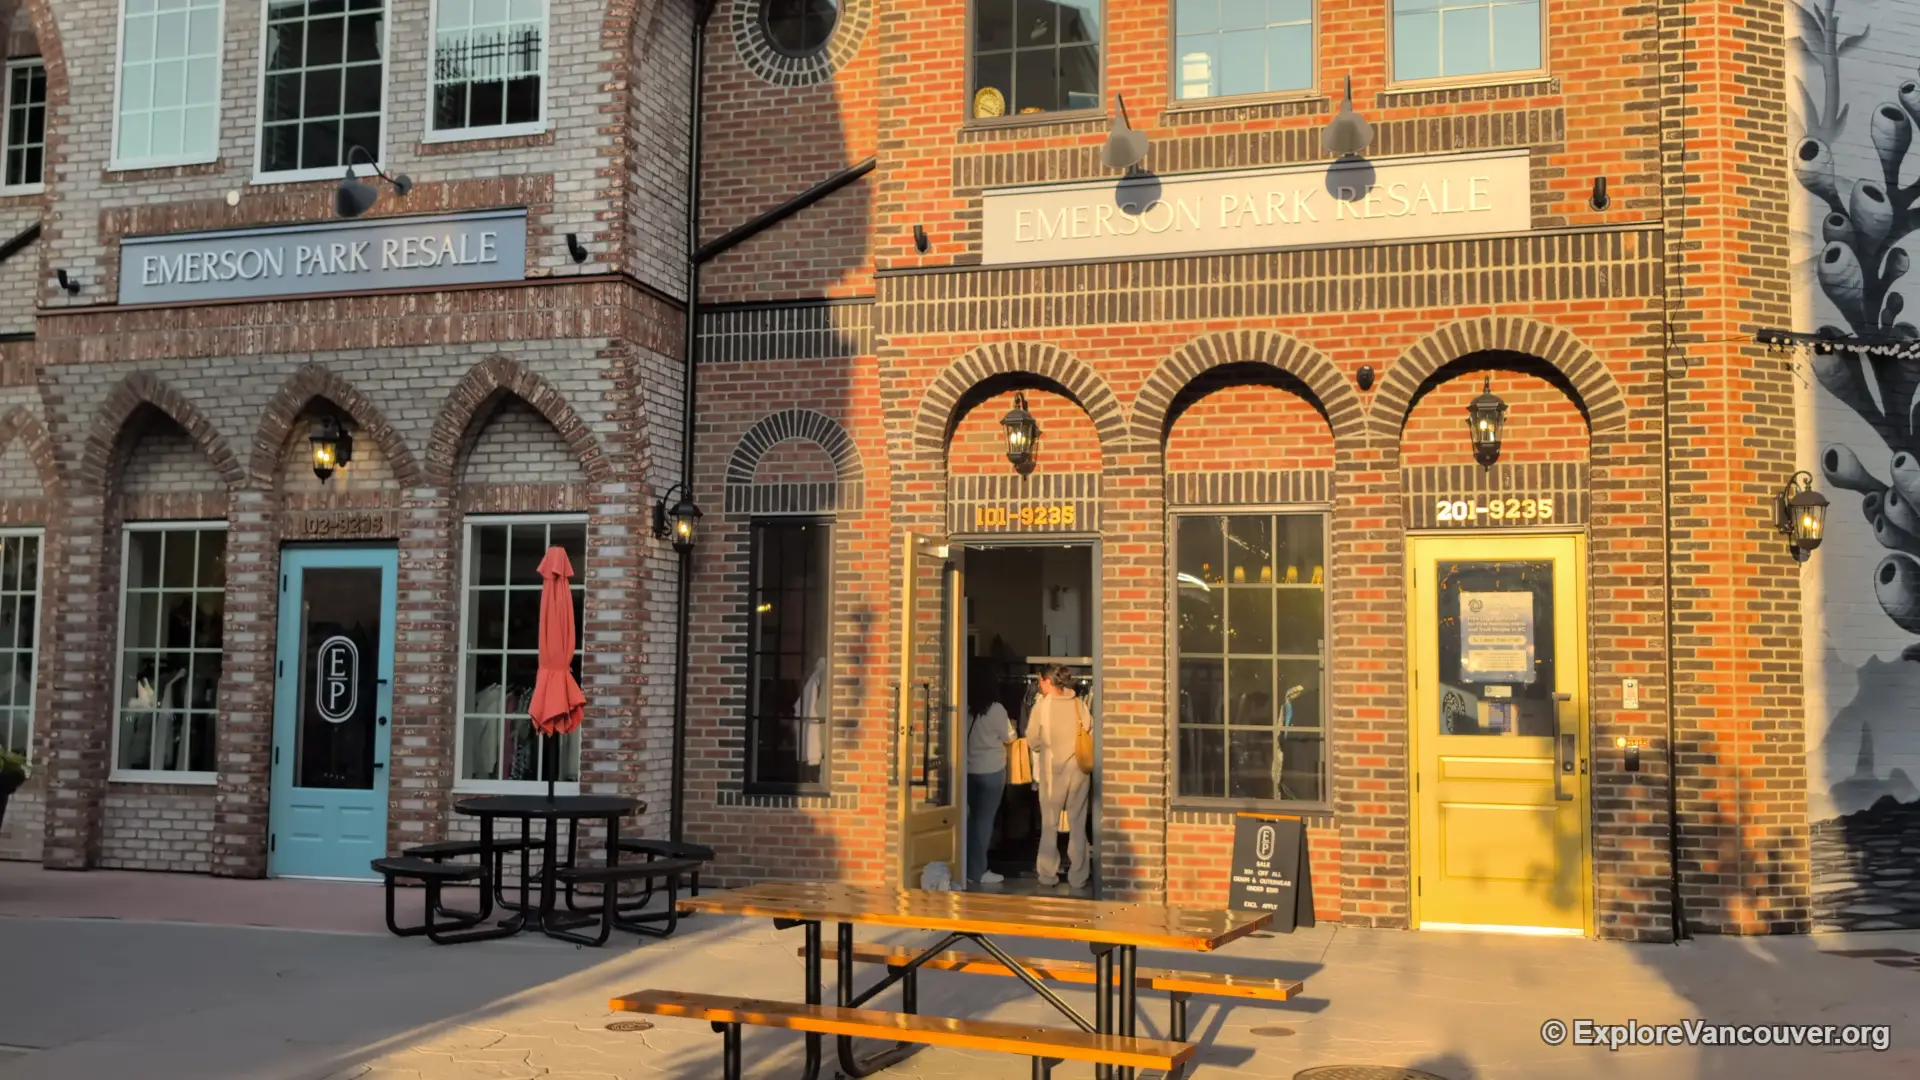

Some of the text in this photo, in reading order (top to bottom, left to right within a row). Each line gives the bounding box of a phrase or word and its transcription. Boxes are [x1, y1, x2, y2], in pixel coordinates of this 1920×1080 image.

[1014, 175, 1492, 243] EMERSON PARK RESALE
[142, 231, 498, 286] EMERSON PARK RESALE
[975, 504, 1075, 526] 101-9235
[1436, 498, 1553, 521] 201-9235
[330, 648, 346, 677] E
[329, 681, 346, 710] P
[1259, 878, 1291, 886] OUTERWEAR
